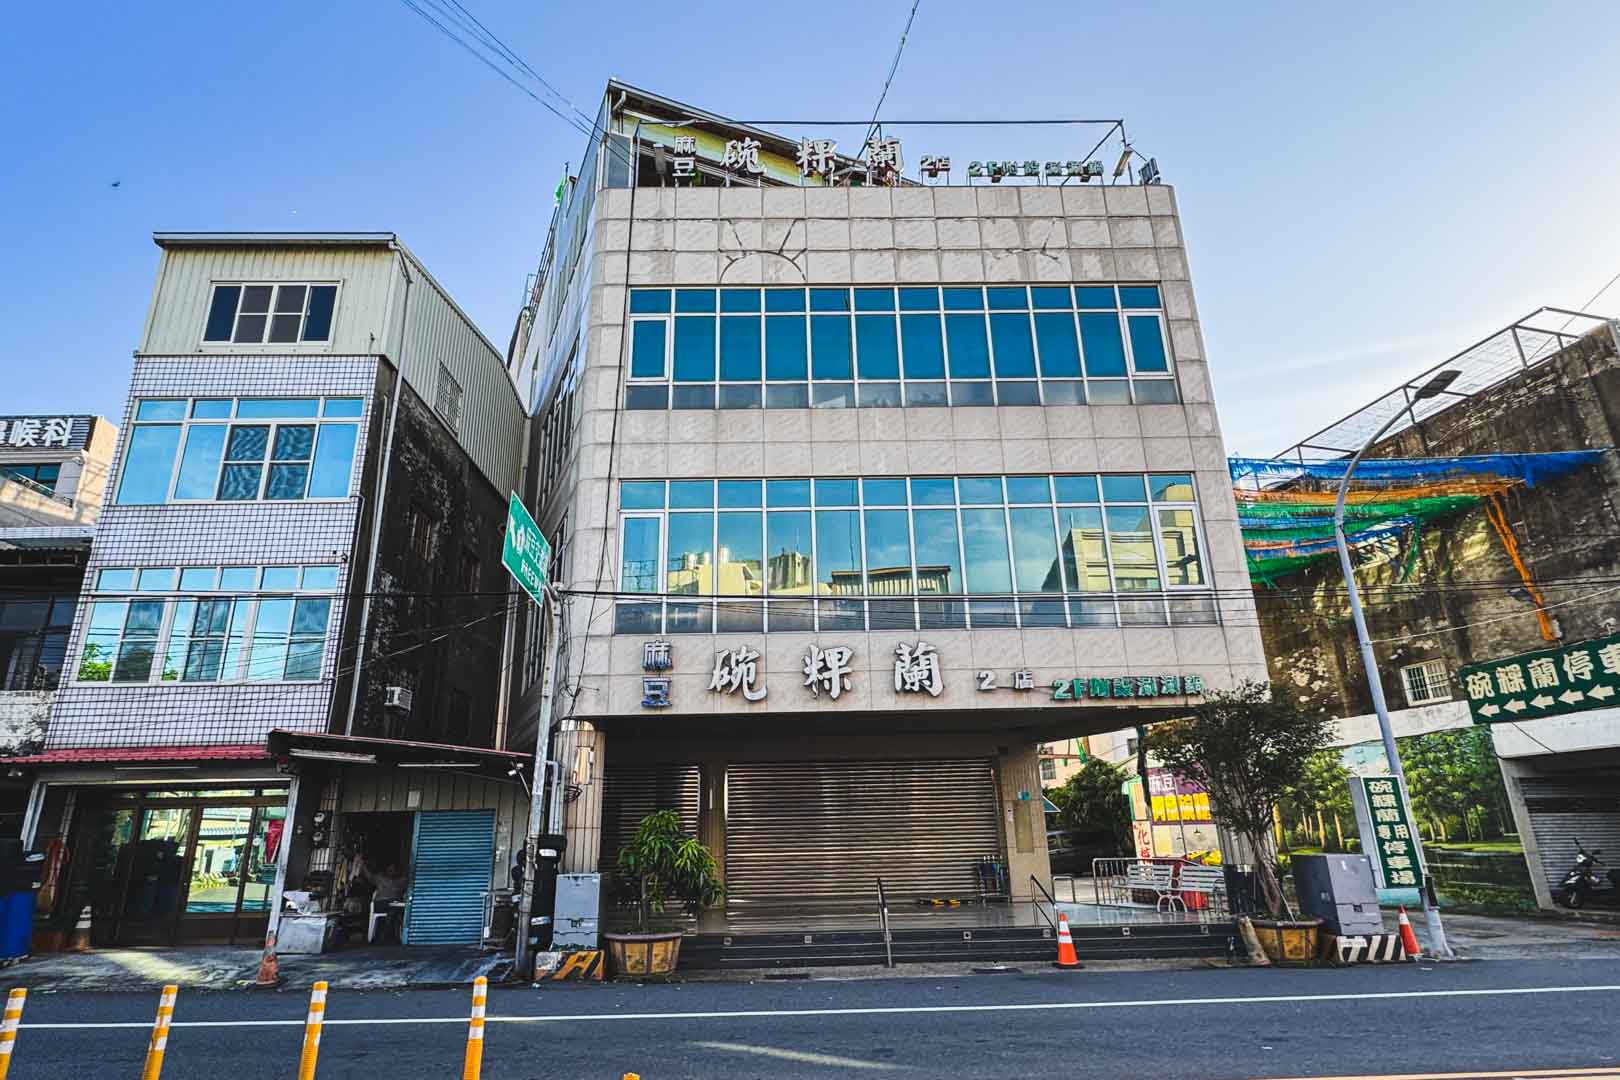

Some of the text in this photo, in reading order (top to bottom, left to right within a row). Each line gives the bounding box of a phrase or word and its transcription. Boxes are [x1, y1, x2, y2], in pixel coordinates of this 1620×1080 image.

[673, 136, 696, 177] 麻豆
[720, 136, 904, 177] 碗粿蘭
[0, 418, 74, 447] 喉科
[643, 640, 672, 707] 麻豆
[707, 641, 944, 701] 碗粿蘭
[976, 670, 1035, 690] 2店
